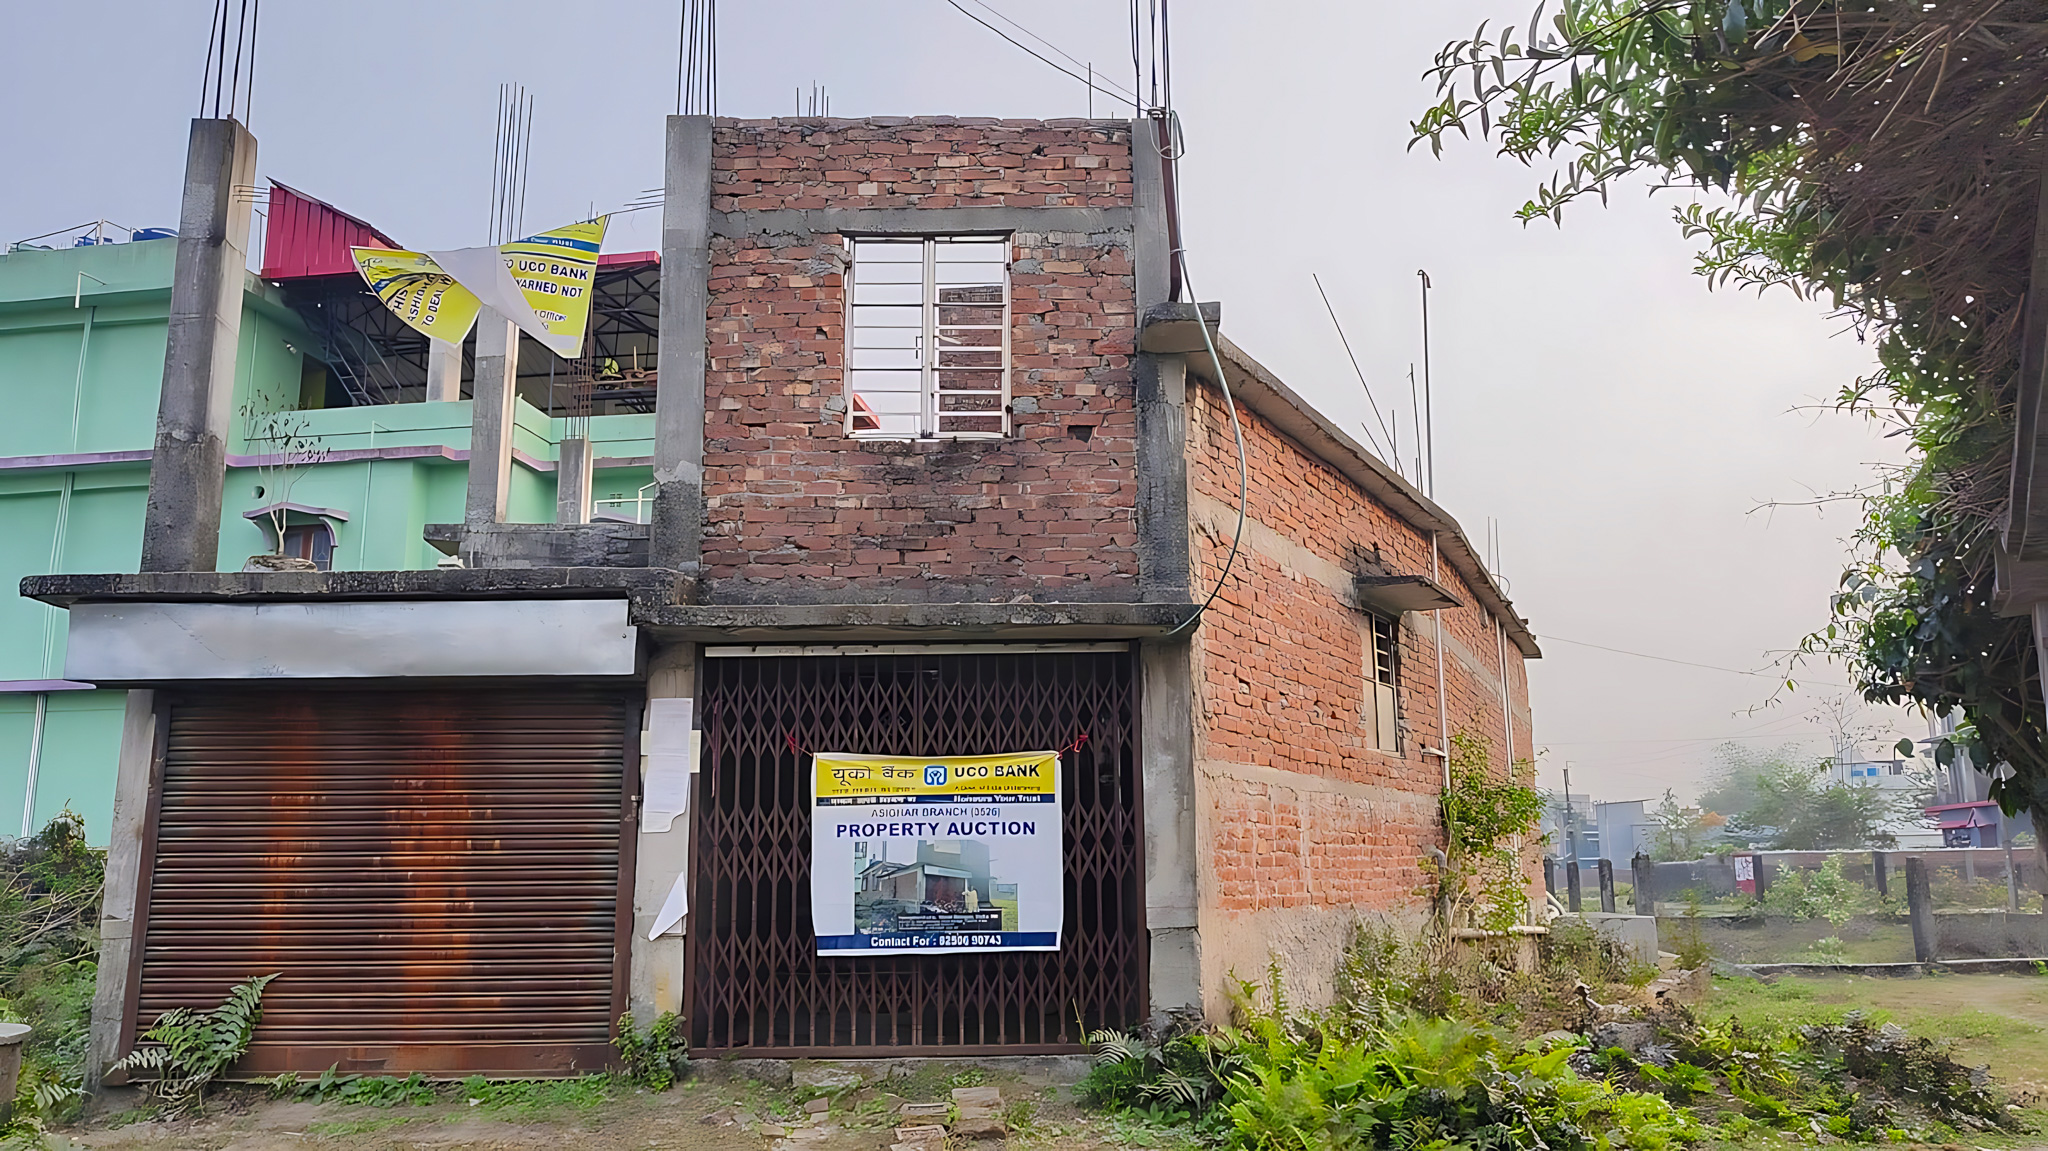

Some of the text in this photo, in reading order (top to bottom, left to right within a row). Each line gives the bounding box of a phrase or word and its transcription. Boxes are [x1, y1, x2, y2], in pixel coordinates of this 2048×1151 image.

[519, 260, 546, 272] UCO
[550, 264, 588, 280] BANK
[561, 285, 583, 298] NOT
[421, 314, 435, 326] TO
[428, 290, 445, 313] DEAL
[831, 765, 874, 786] यूको
[954, 764, 1040, 777] UCO BANK
[1017, 794, 1041, 802] Trust
[922, 807, 968, 817] BRANCH
[836, 821, 1036, 838] PROPERTY AUCTION
[870, 936, 910, 947] Contact
